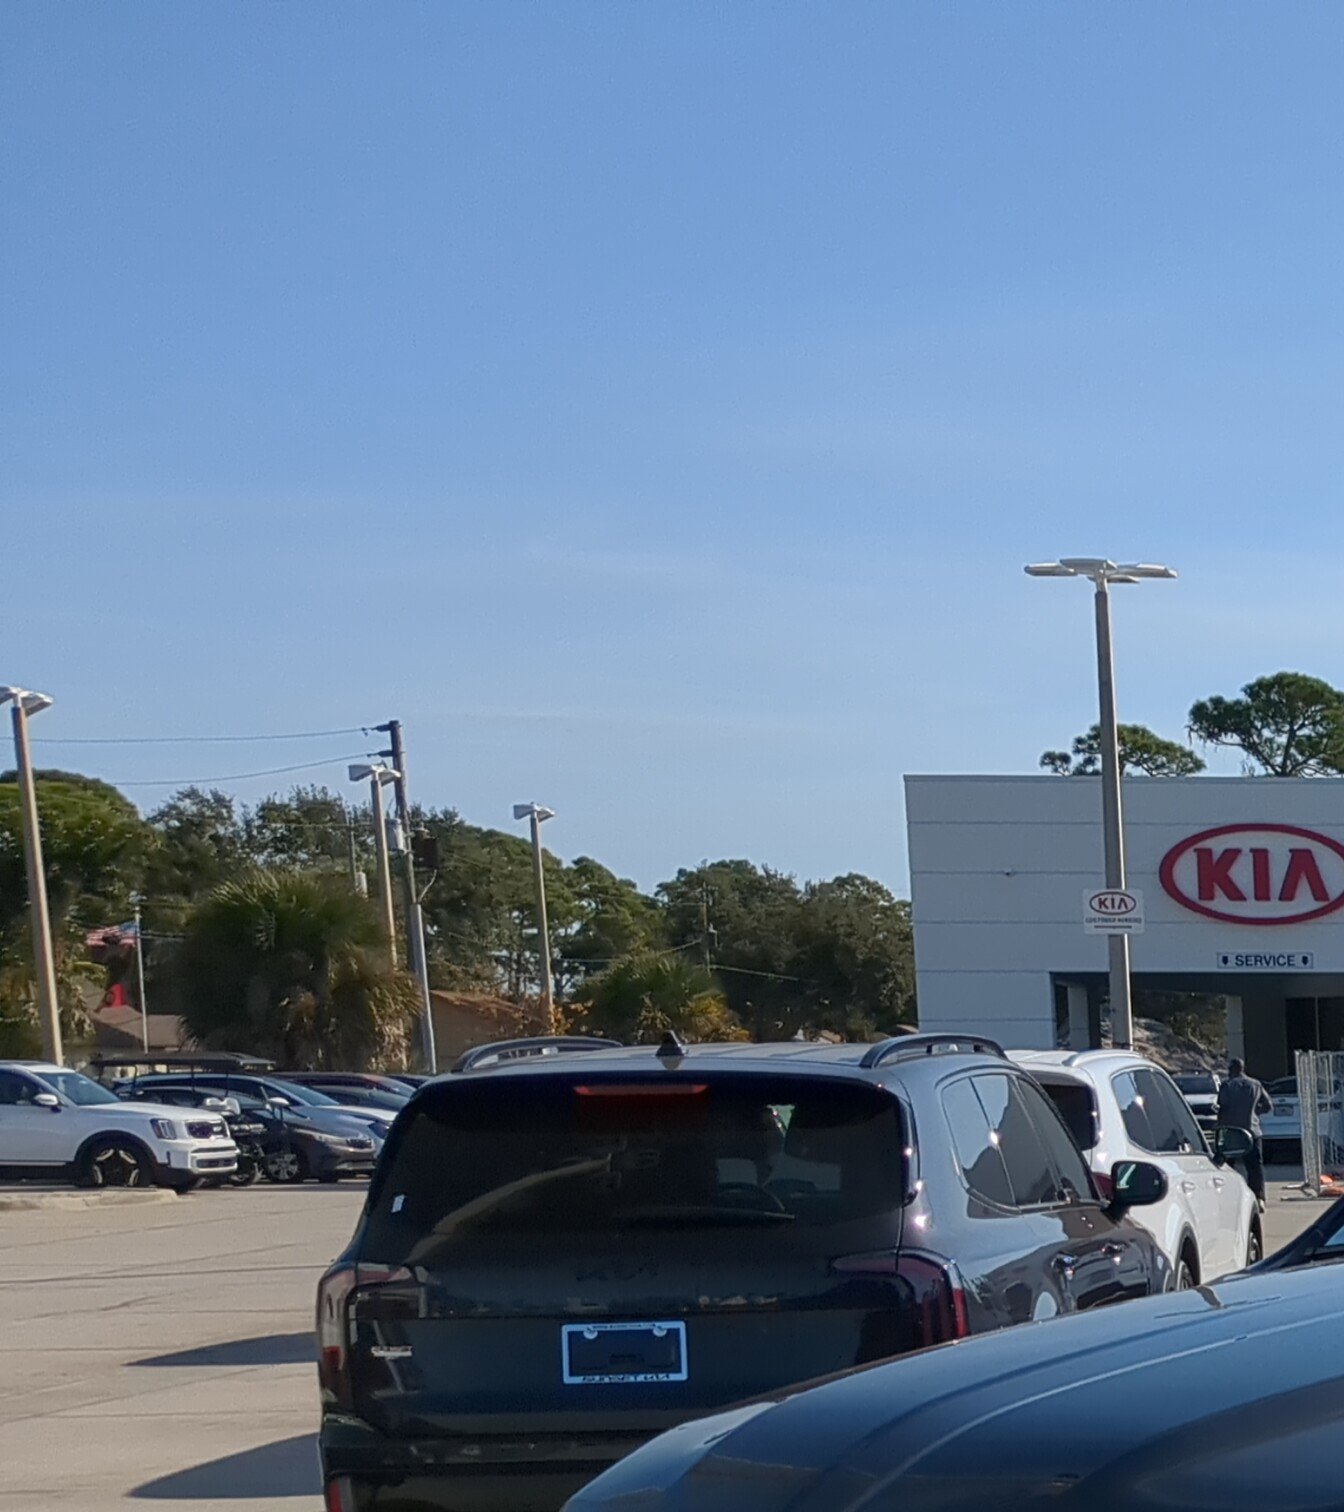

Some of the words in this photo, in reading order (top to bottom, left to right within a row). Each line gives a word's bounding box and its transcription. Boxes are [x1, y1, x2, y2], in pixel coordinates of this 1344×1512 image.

[1193, 847, 1331, 902] KIA
[1097, 897, 1129, 911] KIA
[1234, 955, 1296, 967] SERVICE
